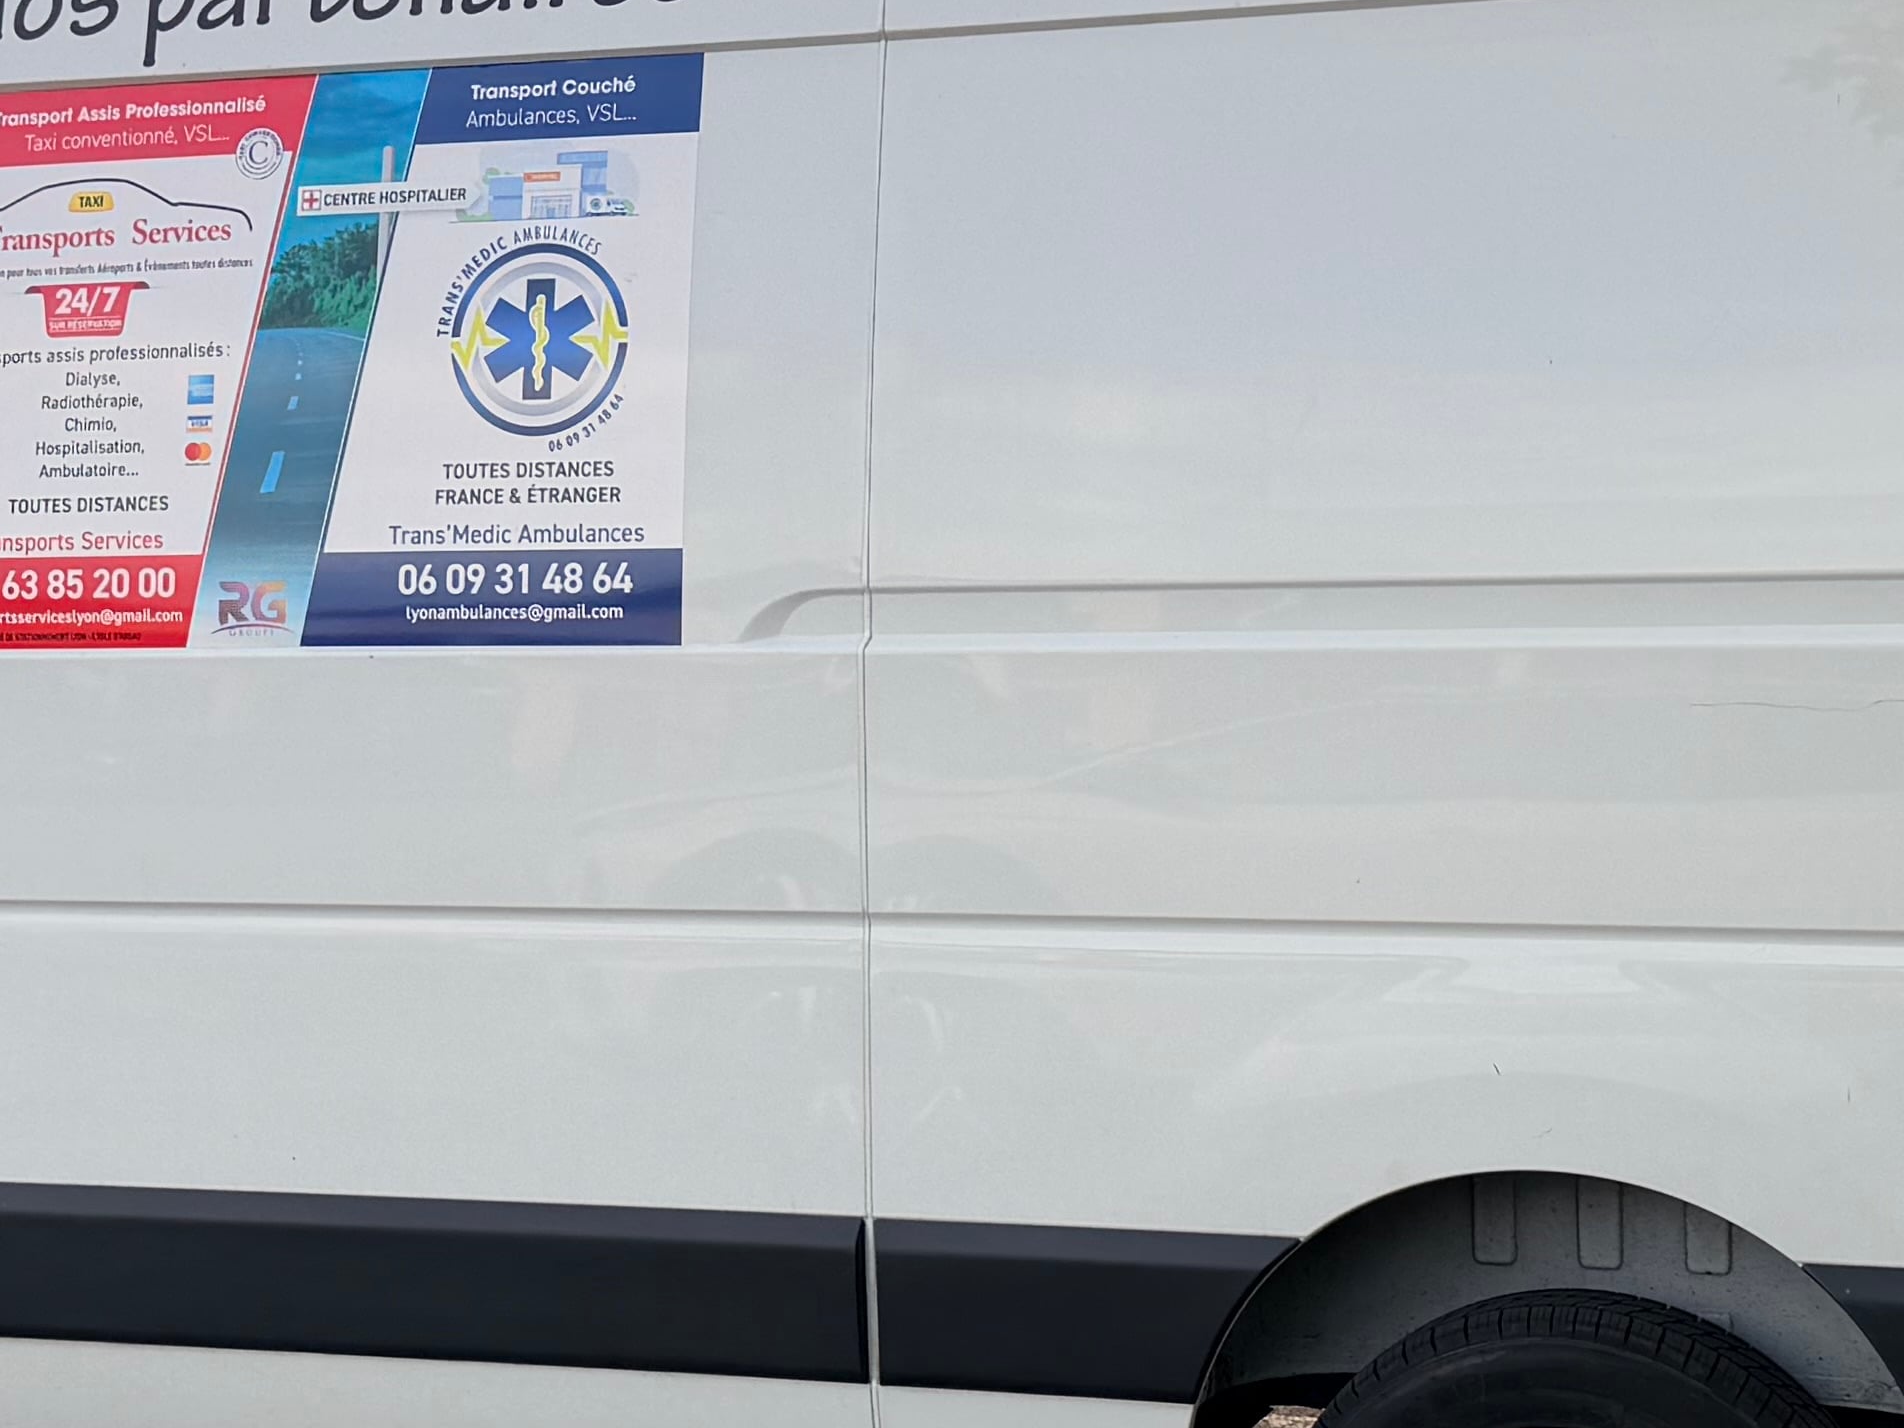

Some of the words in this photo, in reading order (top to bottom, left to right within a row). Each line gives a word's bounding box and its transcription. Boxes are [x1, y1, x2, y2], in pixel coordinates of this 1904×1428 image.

[471, 80, 556, 102] Transport
[562, 75, 636, 96] Couché
[78, 104, 121, 123] Assis
[125, 95, 267, 119] Professionnalisé
[465, 108, 581, 128] Ambulances,
[25, 133, 57, 152] Taxi
[61, 128, 179, 151] conventionné,
[79, 195, 105, 210] TAXI
[323, 191, 376, 207] CENTRE
[379, 187, 467, 205] HOSPITALIER
[131, 218, 232, 246] Services
[437, 236, 508, 338] TRANS'MEDIC
[513, 225, 602, 256] AMBULANCES
[54, 286, 121, 317] 24/7
[46, 348, 84, 364] assis
[90, 341, 223, 364] professionnalisés
[65, 372, 121, 389] Dialyse,
[41, 395, 144, 411] Radiothérapie,
[64, 417, 118, 433] Chimio,
[548, 439, 563, 452] 06
[566, 432, 581, 447] 09
[581, 423, 597, 439] 31
[597, 409, 613, 424] 48
[610, 394, 625, 411] 64
[35, 440, 145, 458] Hospitalisation,
[38, 463, 140, 478] Ambulatoire...
[443, 462, 511, 480] TOUTES
[516, 460, 615, 478] DISTANCES
[8, 497, 72, 514] TOUTES
[77, 495, 169, 514] DISTANCES
[435, 489, 504, 505] FRANCE
[509, 489, 522, 504] &
[527, 484, 622, 503] ÉTRANGER
[81, 530, 164, 551] Services
[389, 524, 512, 545] Trans'Medic
[518, 524, 645, 544] Ambulances
[1, 569, 39, 600] 63
[47, 569, 84, 599] 85
[92, 568, 131, 599] 20
[138, 567, 176, 598] 00
[398, 563, 438, 596] 06
[445, 563, 486, 595] 09
[494, 562, 530, 595] 31
[542, 562, 583, 594] 48
[592, 561, 634, 594] 64
[219, 581, 287, 626] RG
[406, 603, 624, 623] lyonambulances@gmail.com
